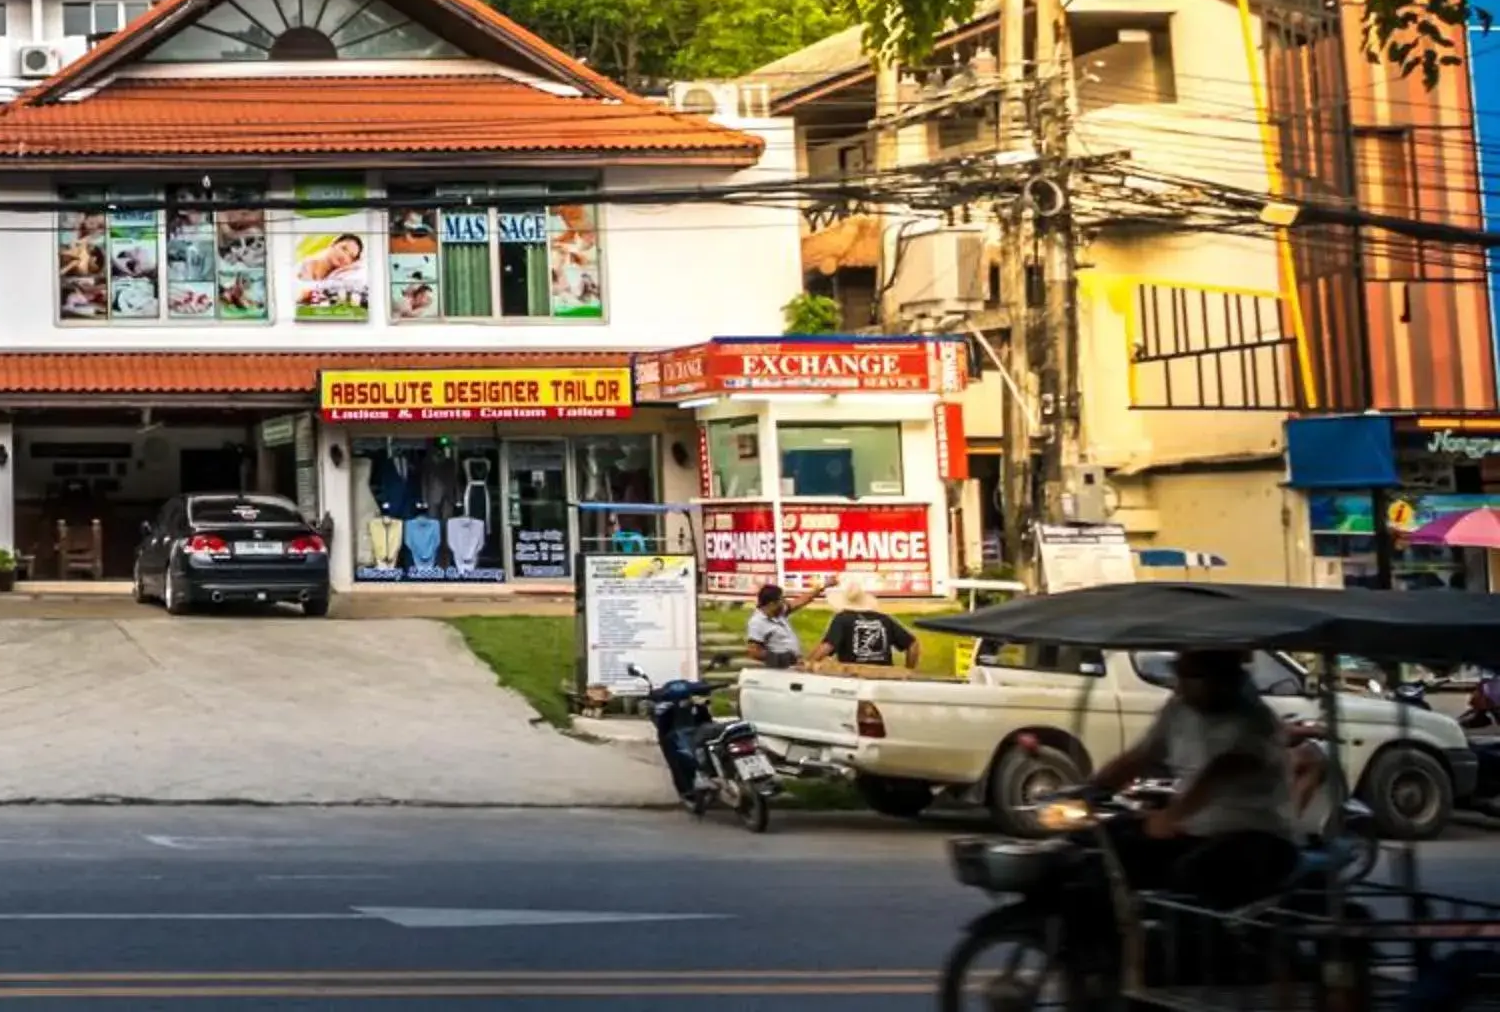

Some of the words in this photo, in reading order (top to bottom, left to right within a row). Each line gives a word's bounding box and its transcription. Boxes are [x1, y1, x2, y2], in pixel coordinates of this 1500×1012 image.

[445, 214, 486, 240] MAS
[498, 214, 546, 240] SAGE
[741, 354, 901, 376] EXCHANGE
[331, 381, 433, 405] ABSOLUTE
[443, 380, 539, 404] DESIGNER
[550, 379, 621, 403] TAILOR
[331, 408, 389, 420] Ladies
[397, 408, 413, 419] &
[421, 408, 471, 419] Gents
[480, 407, 547, 418] Custom
[557, 407, 617, 418] Tailors
[705, 532, 776, 560] EXCHANGE
[781, 531, 928, 560] EXCHANGE
